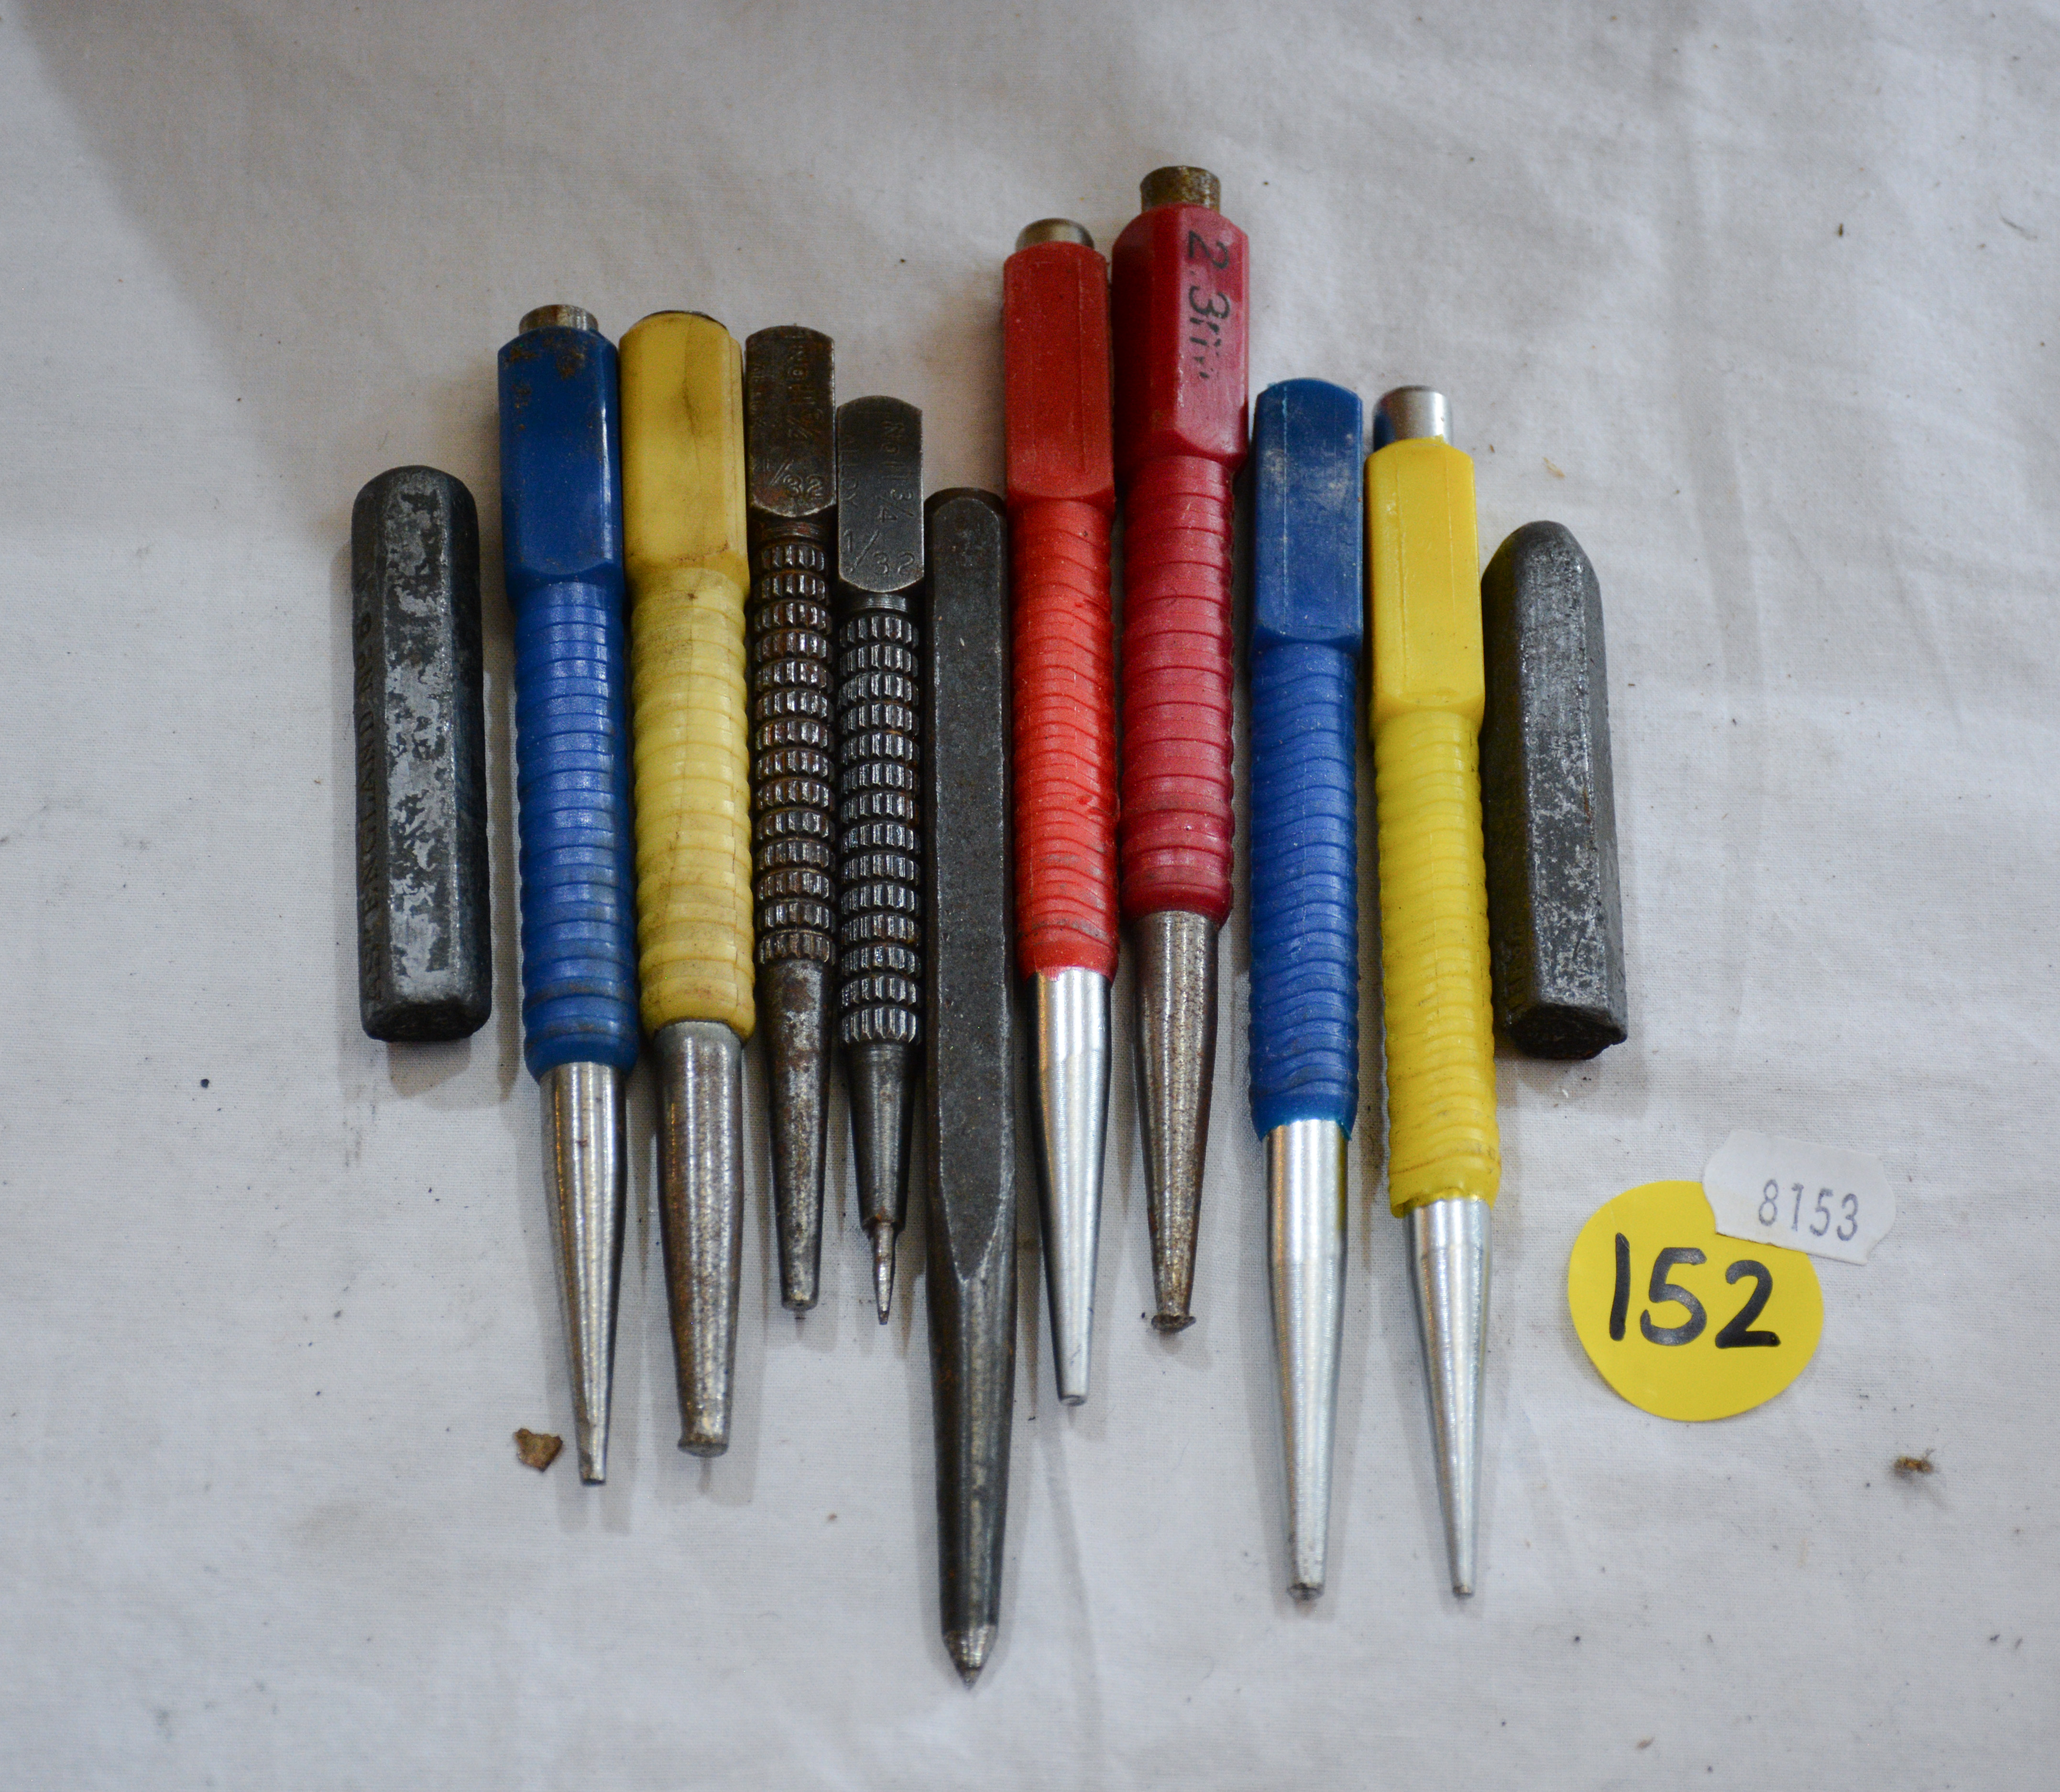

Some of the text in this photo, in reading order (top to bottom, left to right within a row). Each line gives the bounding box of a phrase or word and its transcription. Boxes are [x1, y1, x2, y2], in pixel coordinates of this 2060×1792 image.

[844, 528, 915, 575] 1/32
[1758, 1179, 1859, 1241] 8153
[1609, 1232, 1781, 1349] 152
